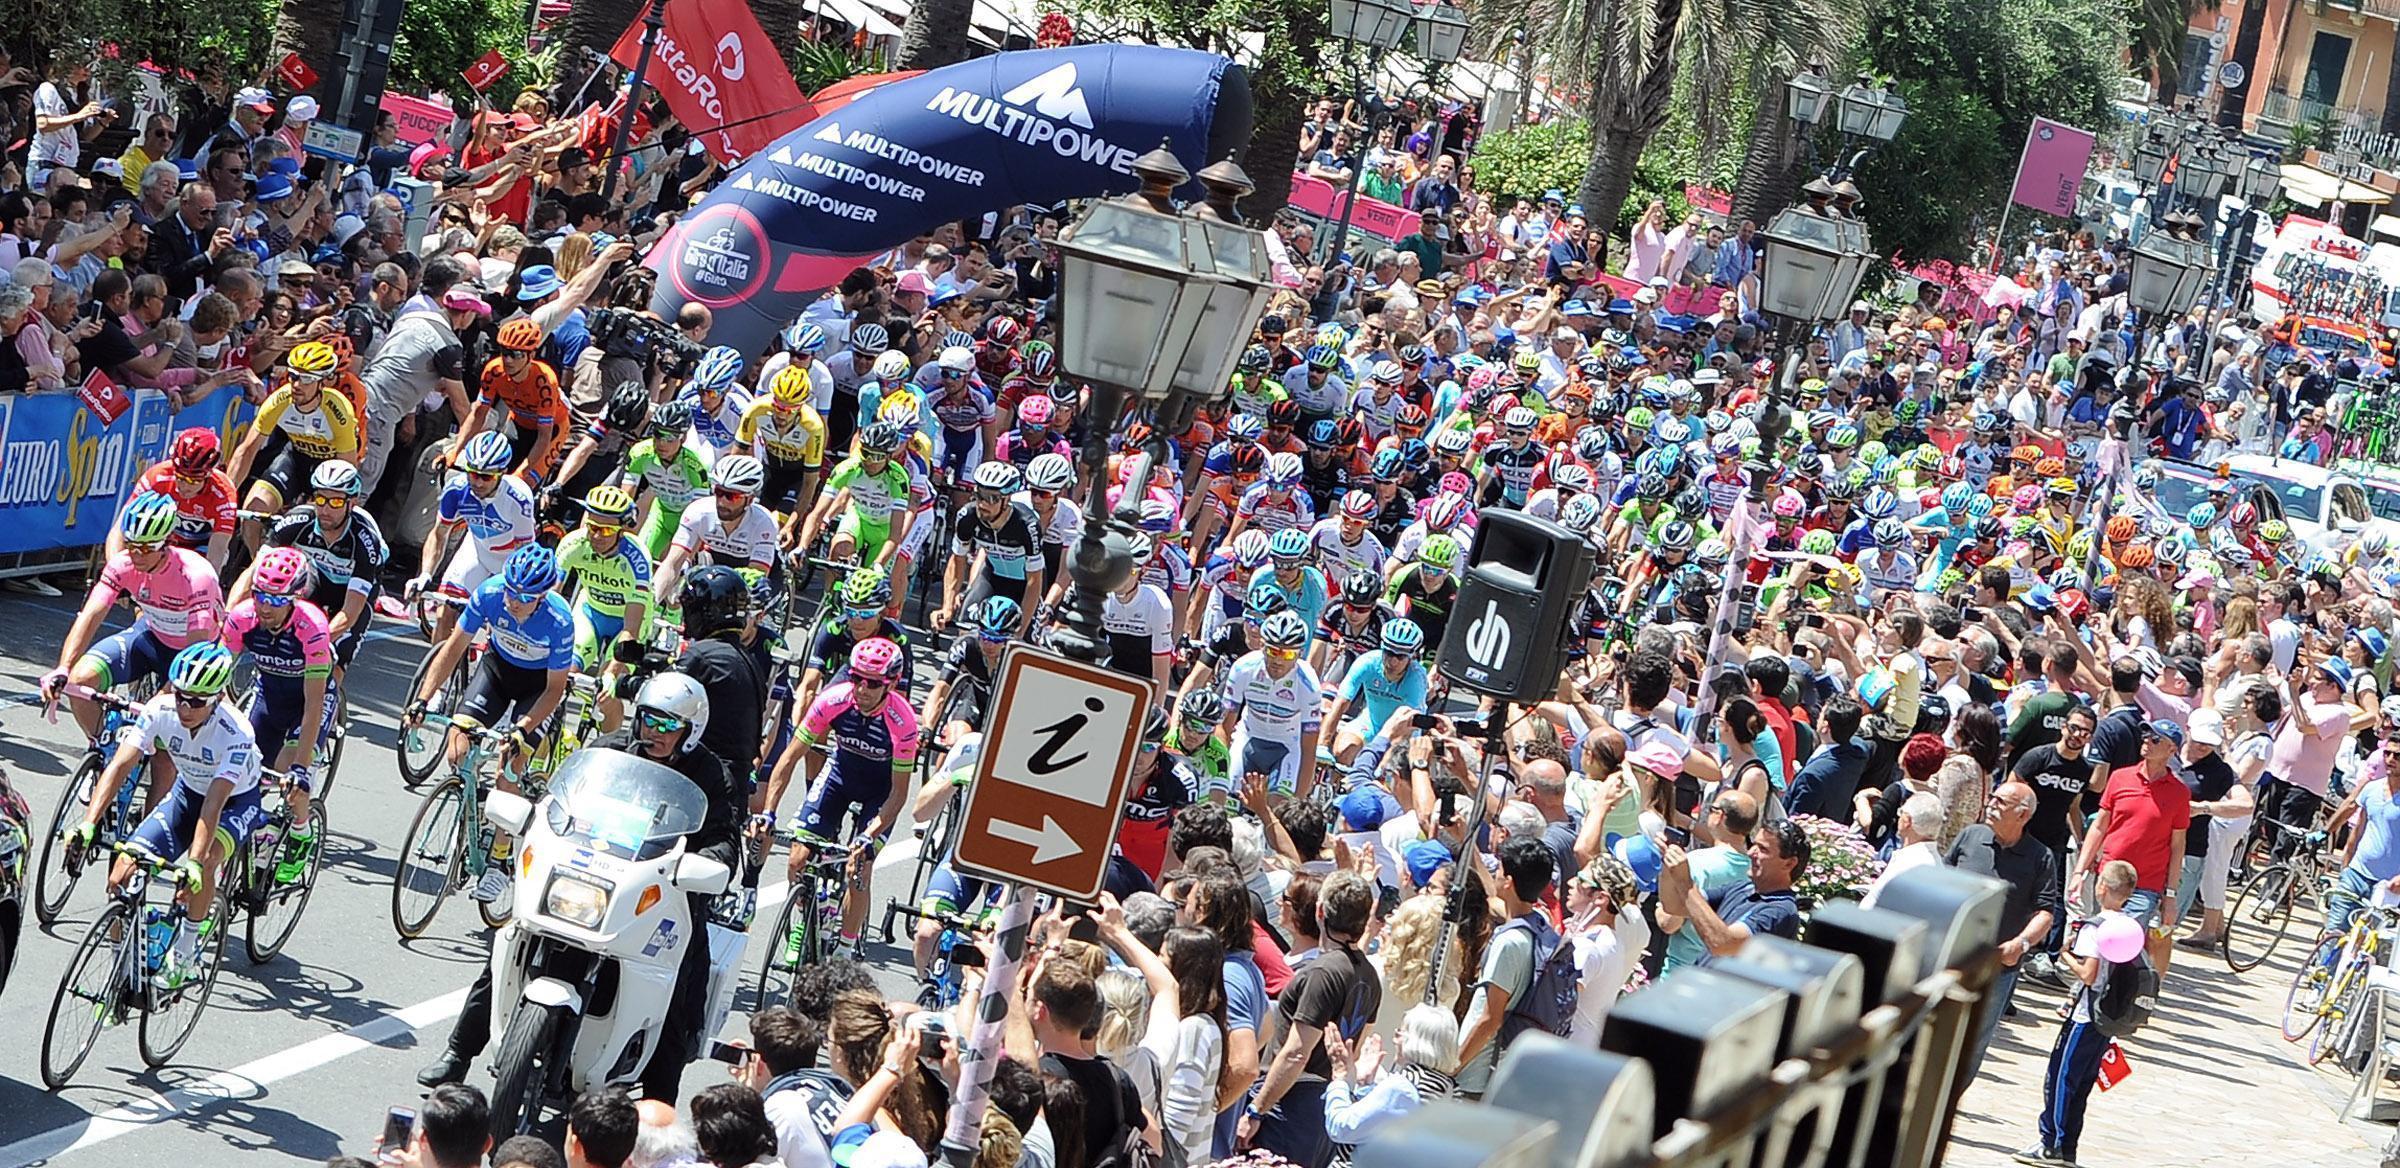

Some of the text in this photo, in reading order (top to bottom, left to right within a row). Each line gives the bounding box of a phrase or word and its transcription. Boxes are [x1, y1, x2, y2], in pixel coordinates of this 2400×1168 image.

[2197, 16, 2231, 97] HOTEL
[926, 86, 1144, 176] MULTIPOWE
[794, 152, 926, 202] MULTIPOWER
[843, 130, 985, 187] MULTIPOWER
[755, 177, 878, 222] MULTIPOWER
[2055, 179, 2074, 208] VERDI
[1367, 209, 1396, 226] VERDI
[536, 375, 552, 408] CCC
[1, 407, 124, 527] EURO Spin
[624, 545, 648, 574] SAXO
[1171, 761, 1198, 802] BMC
[2035, 772, 2085, 794] OAKLEY
